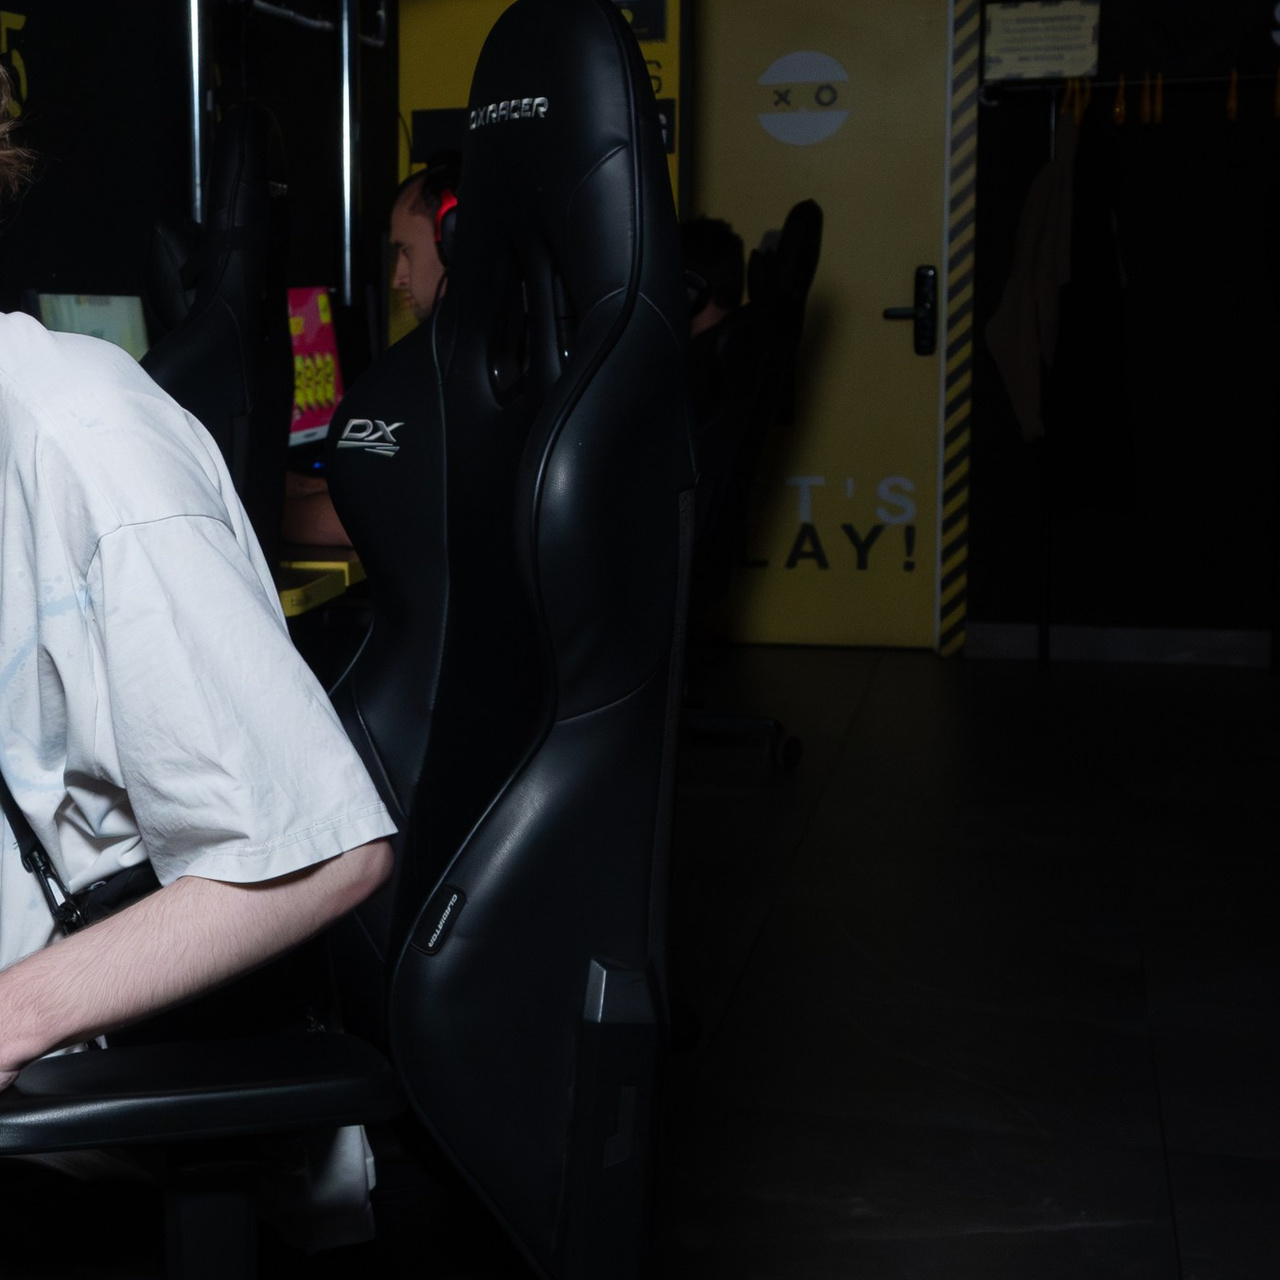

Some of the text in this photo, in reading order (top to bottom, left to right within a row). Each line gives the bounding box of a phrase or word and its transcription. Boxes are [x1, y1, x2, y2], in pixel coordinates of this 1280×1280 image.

[469, 96, 550, 131] DXRACER
[341, 418, 406, 443] DX
[785, 475, 918, 526] T'S
[742, 522, 917, 572] AY!
